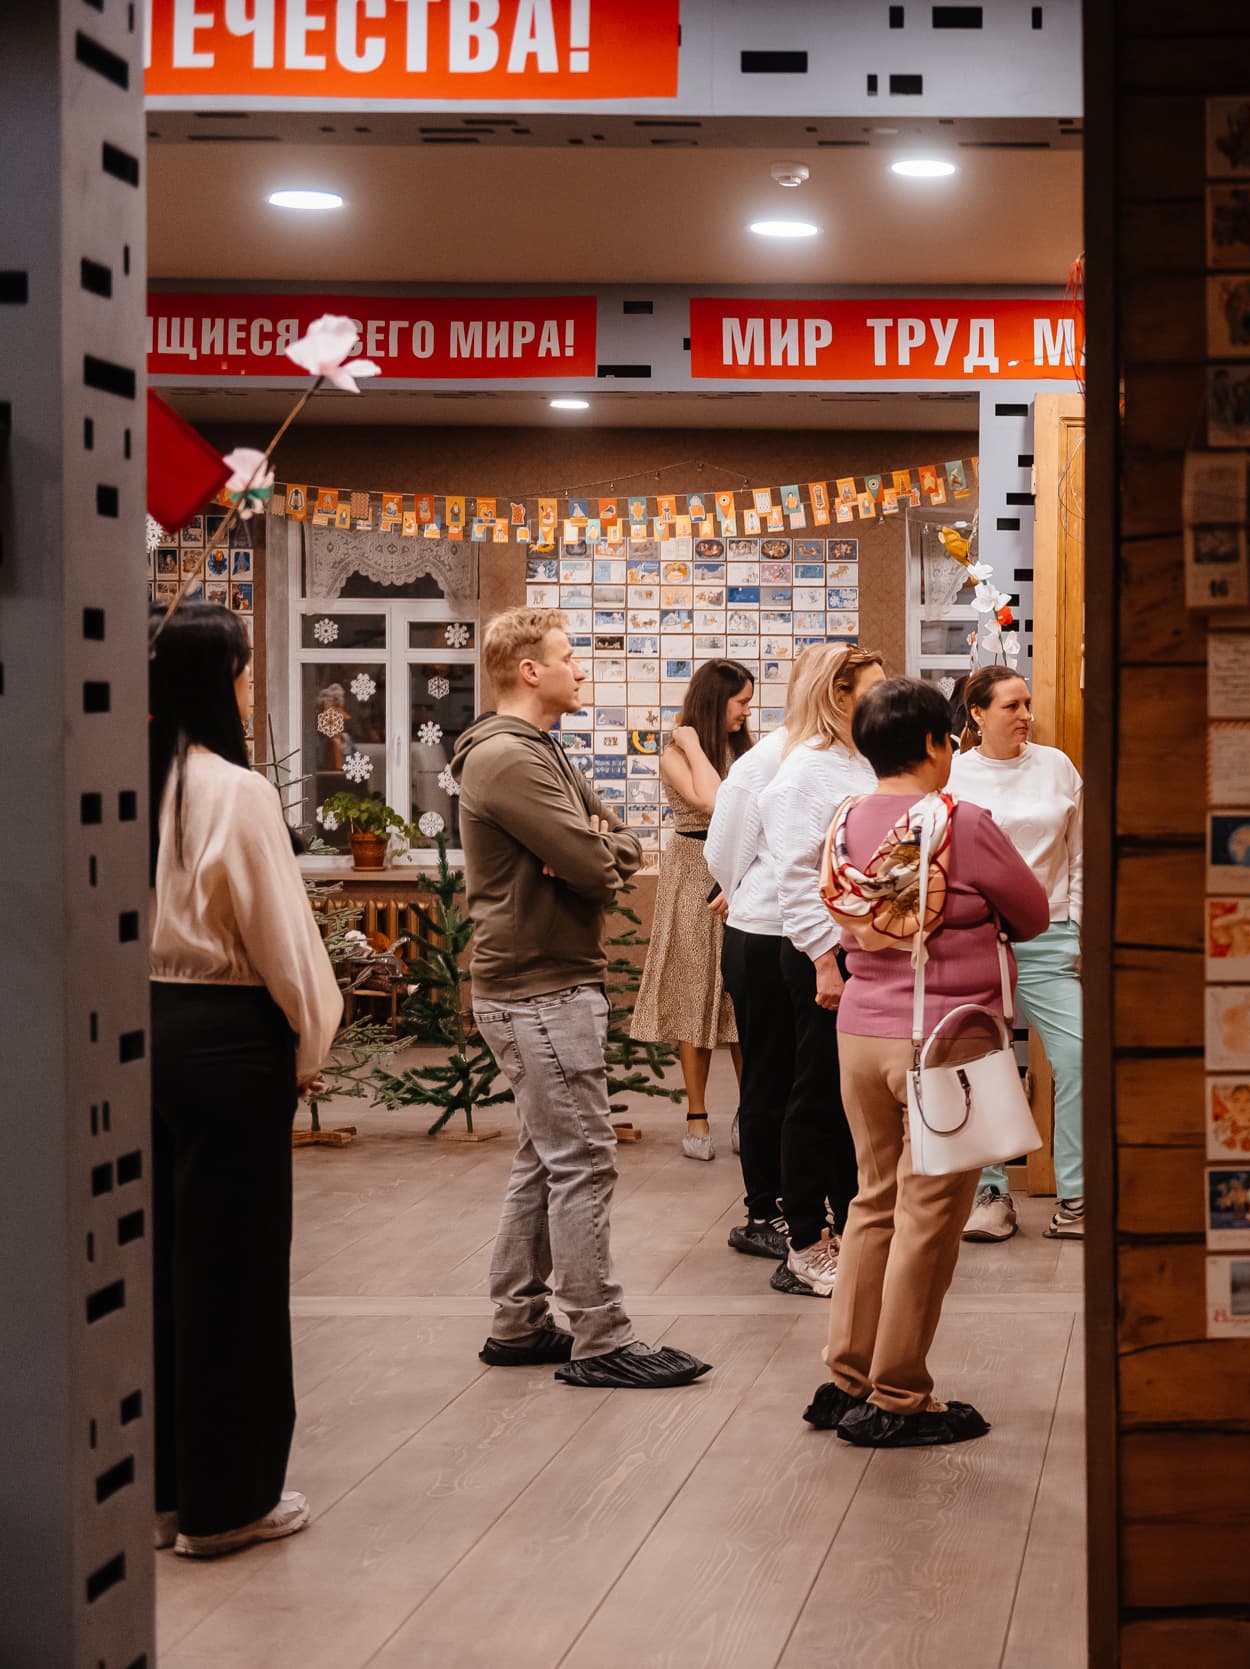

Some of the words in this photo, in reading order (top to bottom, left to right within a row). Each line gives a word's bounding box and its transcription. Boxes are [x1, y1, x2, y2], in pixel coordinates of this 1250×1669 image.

[348, 319, 435, 358] ЕГО
[450, 319, 575, 359] МИРА!
[722, 317, 833, 367] МИР
[866, 318, 1000, 373] ТРУД
[1033, 318, 1085, 367] М
